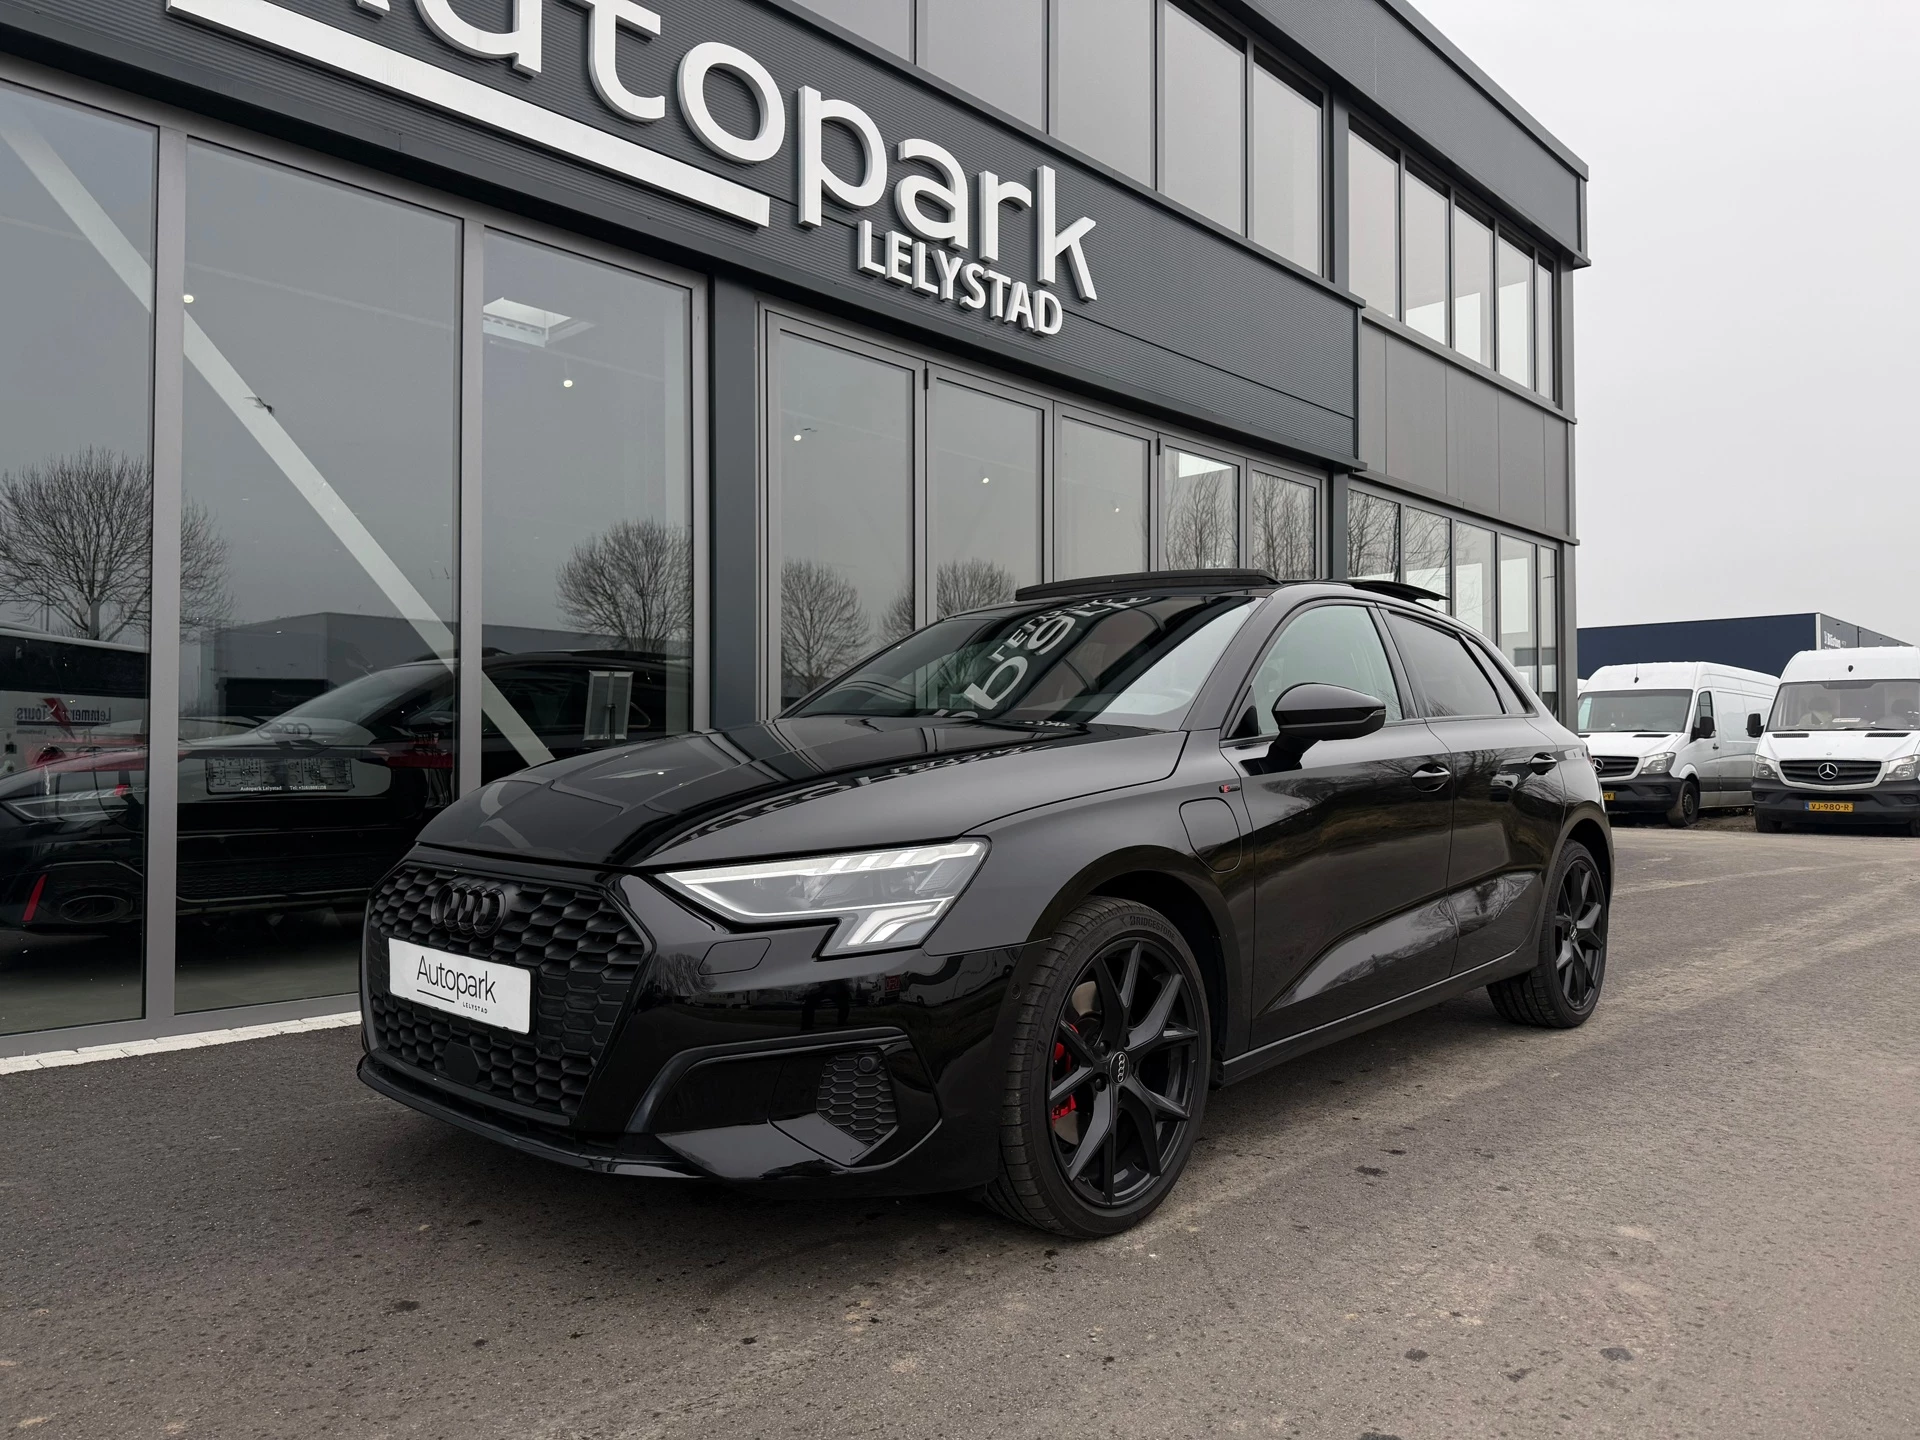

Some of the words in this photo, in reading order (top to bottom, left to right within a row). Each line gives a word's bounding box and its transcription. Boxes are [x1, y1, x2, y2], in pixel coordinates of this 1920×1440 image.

[357, 0, 1097, 300] utopark
[857, 219, 1063, 335] LELYSTAD
[1810, 803, 1850, 811] VJ-980-R
[1129, 915, 1176, 942] BRIDGESTONE
[416, 954, 497, 1004] Autopark
[462, 1001, 488, 1014] LELYSTAD
